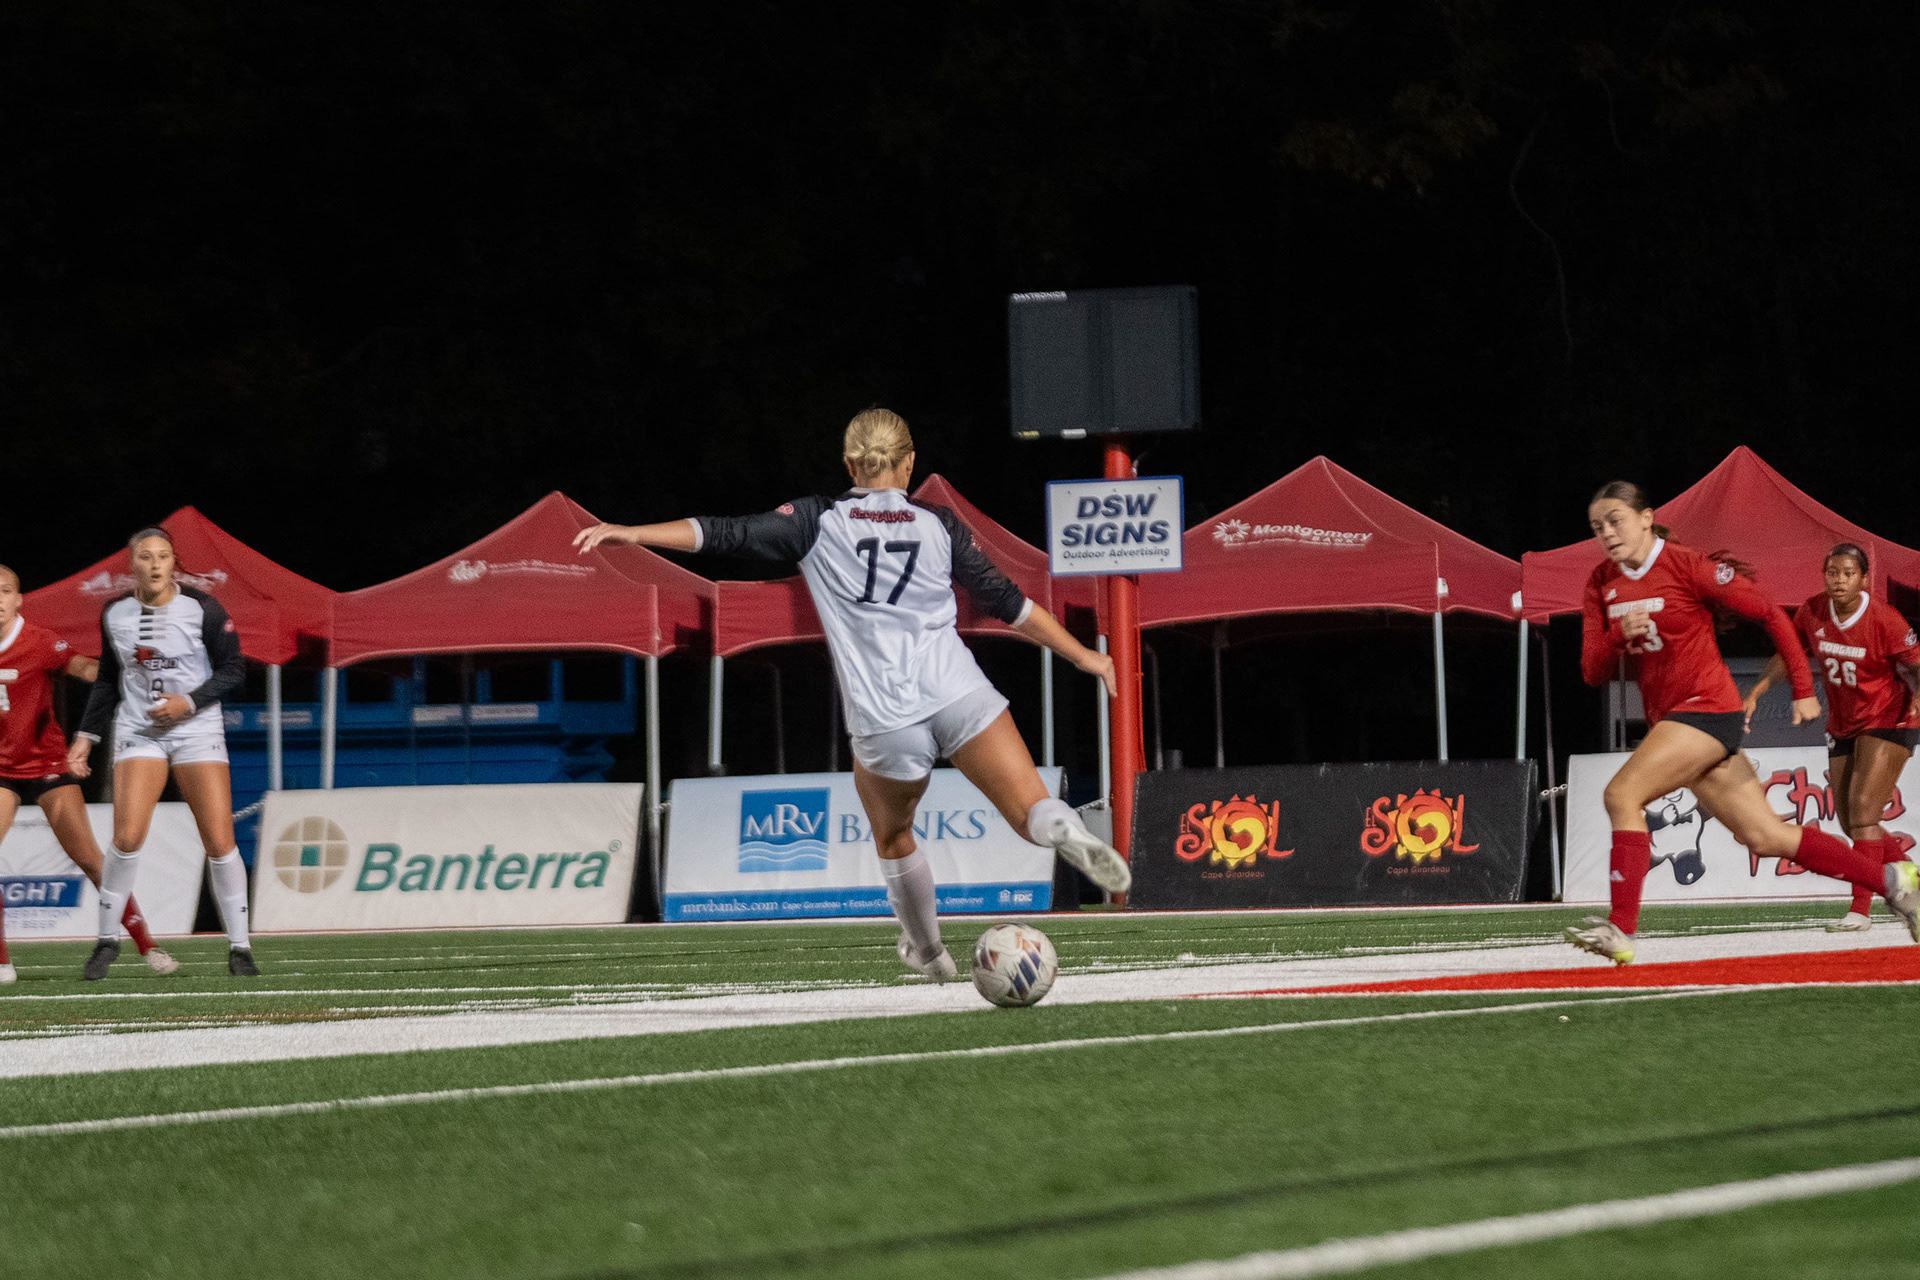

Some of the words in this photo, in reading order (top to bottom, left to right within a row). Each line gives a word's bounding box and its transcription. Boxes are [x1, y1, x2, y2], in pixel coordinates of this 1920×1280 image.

[1077, 493, 1157, 519] DSW
[1061, 520, 1169, 547] SIGNS
[1253, 524, 1373, 541] Montgomery
[1063, 550, 1105, 559] Outdoor
[1109, 547, 1169, 558] Advertising
[856, 537, 921, 605] 17
[143, 657, 178, 671] SEMO
[1825, 658, 1857, 686] 26
[743, 804, 825, 836] MRV
[839, 809, 987, 843] BNKS
[1175, 796, 1295, 862] SOL
[1360, 790, 1480, 855] SOL
[354, 843, 612, 892] Banterra
[1387, 866, 1408, 875] Cape
[1411, 865, 1450, 874] Girardeau
[683, 899, 778, 913] mrvbanks.com
